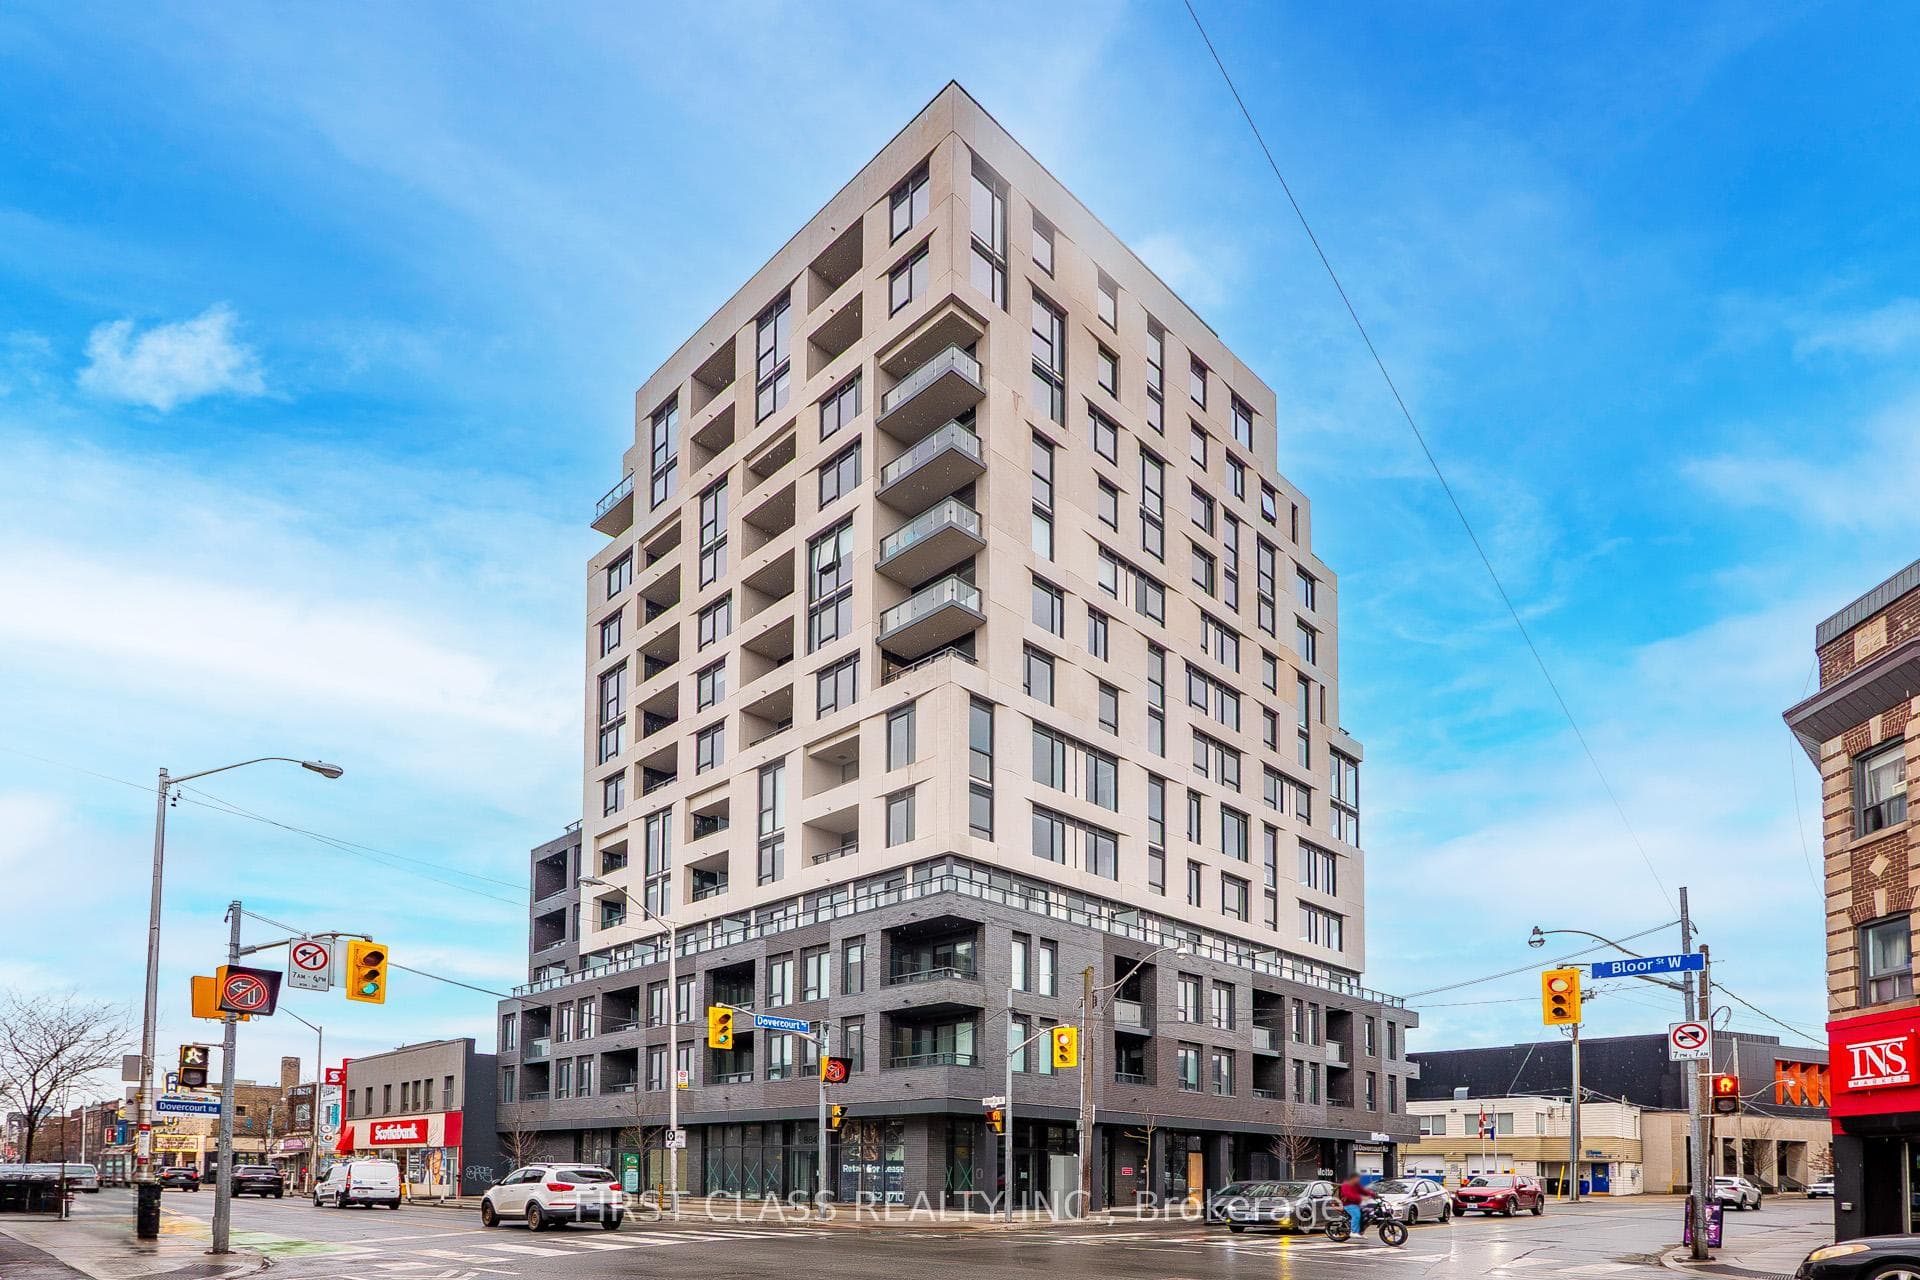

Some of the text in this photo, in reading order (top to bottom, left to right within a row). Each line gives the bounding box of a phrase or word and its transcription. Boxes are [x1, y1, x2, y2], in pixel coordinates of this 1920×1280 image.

[1612, 961, 1653, 974] Bloor
[1668, 956, 1682, 968] W
[757, 1016, 800, 1030] Dovercourt
[1849, 1041, 1907, 1079] INS
[1853, 1075, 1904, 1086] MARKET
[160, 1102, 207, 1112] Dovercourt
[375, 1123, 418, 1140] Scotiabank
[842, 1164, 866, 1173] Retal
